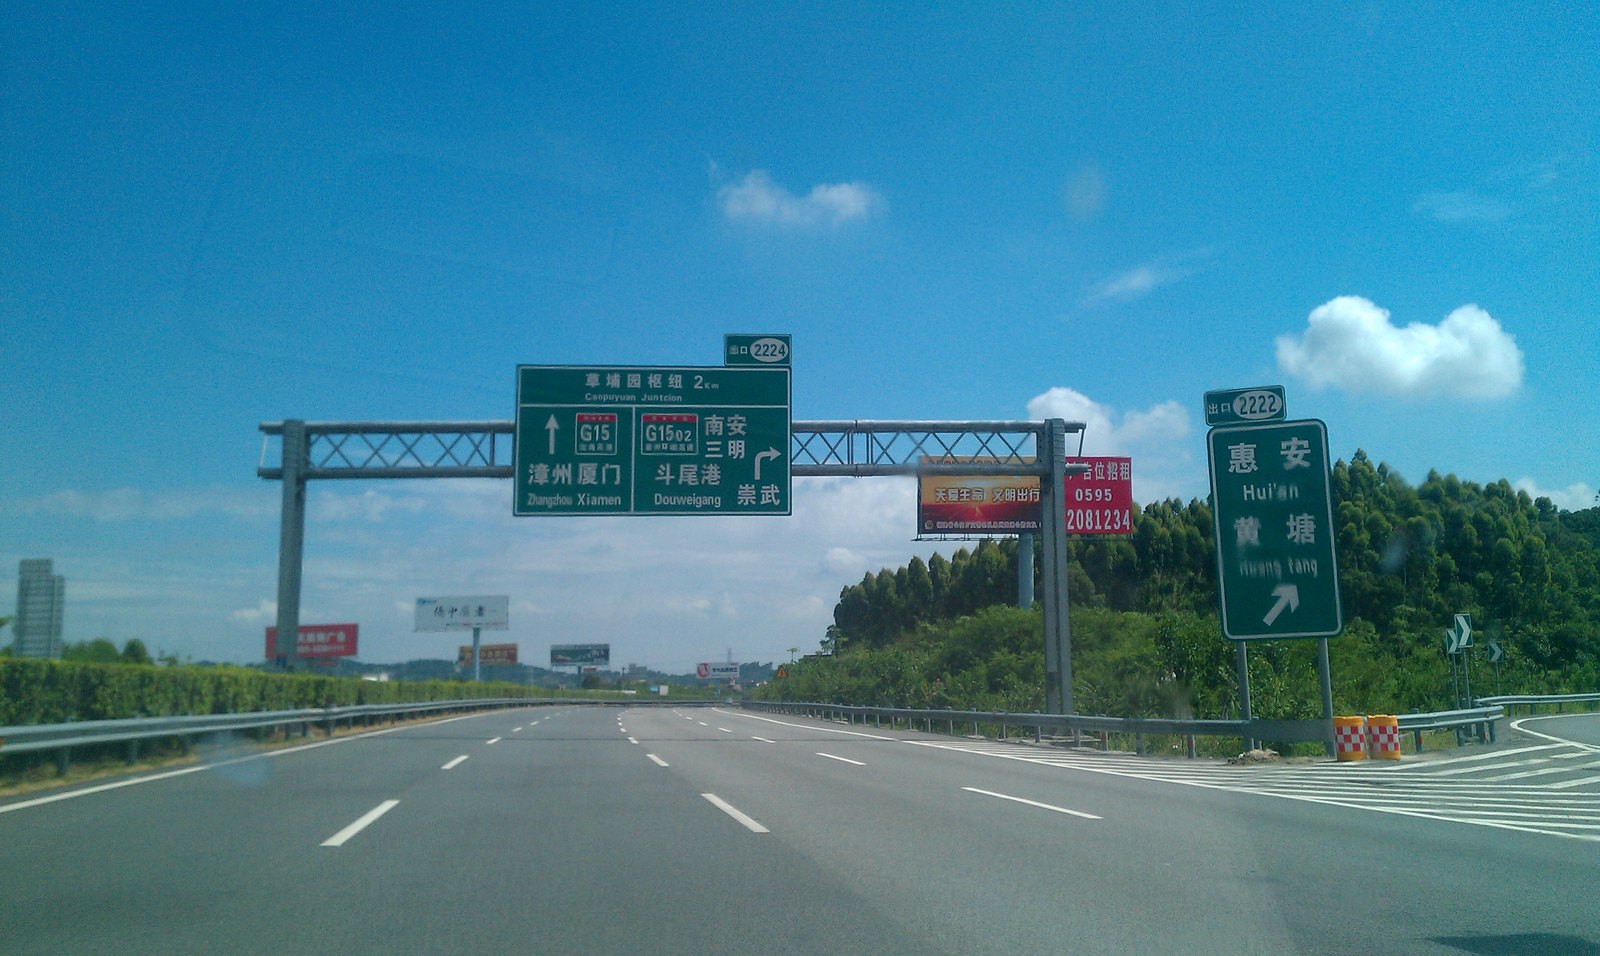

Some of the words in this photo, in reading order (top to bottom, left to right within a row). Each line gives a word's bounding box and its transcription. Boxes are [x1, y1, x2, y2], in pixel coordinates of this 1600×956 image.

[729, 345, 748, 355] 出口
[754, 344, 786, 356] 2224
[585, 393, 636, 403] Caopuyuan
[641, 393, 683, 402] Juntcion
[1208, 402, 1231, 415] 出口
[1239, 395, 1277, 415] 2222
[580, 424, 610, 442] G15
[645, 424, 692, 442] G1502
[704, 414, 748, 436] 南安
[704, 440, 746, 460] 三明
[1227, 436, 1312, 474] 惠安
[528, 463, 573, 486] 漳州
[577, 463, 621, 486] 厦门
[654, 463, 722, 486] 斗尾港
[1069, 461, 1130, 480] 告位招租
[527, 493, 573, 508] Zhangzhou
[577, 493, 622, 506] Xiamen
[654, 493, 722, 508] Douweigang
[737, 484, 781, 506] 崇武
[992, 487, 1040, 502] 文明出行
[1075, 488, 1113, 502] 0595
[1243, 483, 1299, 502] Hui'an
[1067, 508, 1130, 530] 2081234
